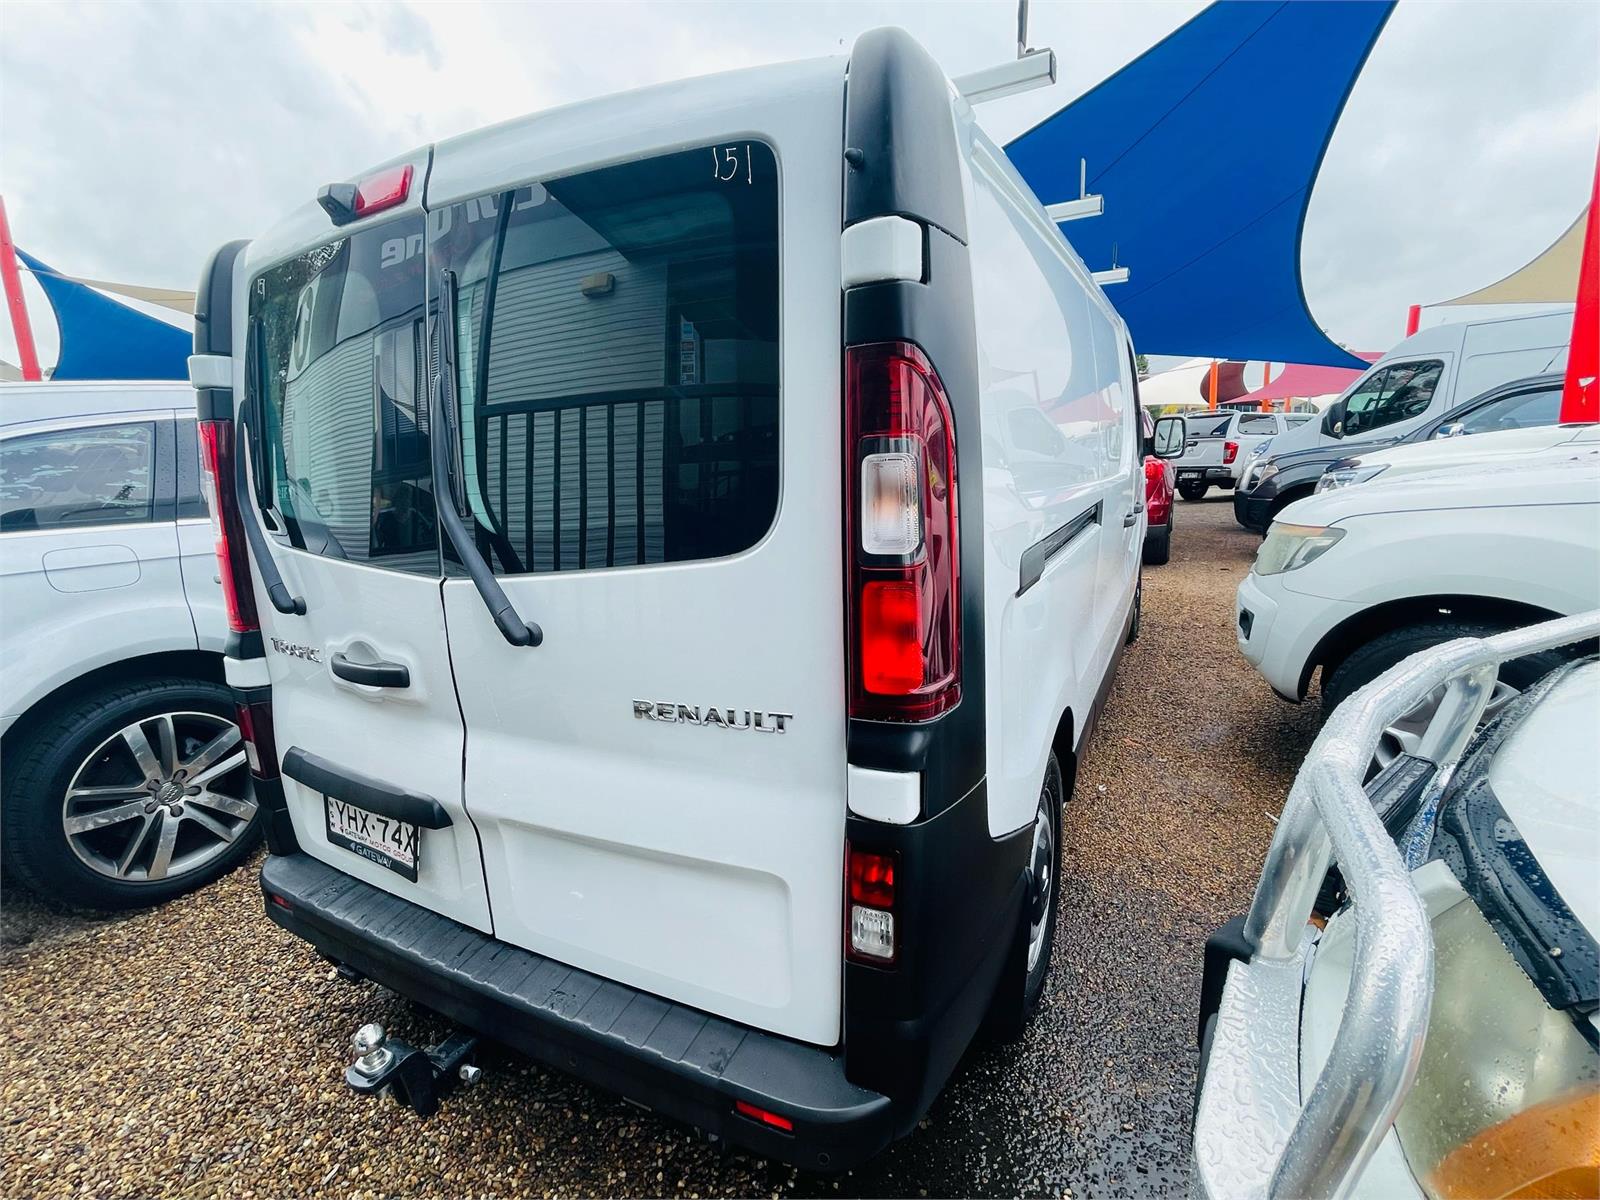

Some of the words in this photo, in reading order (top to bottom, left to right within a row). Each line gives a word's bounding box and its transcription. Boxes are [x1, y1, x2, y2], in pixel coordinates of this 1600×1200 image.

[713, 144, 752, 185] 151
[632, 698, 793, 734] RENAULT
[355, 845, 393, 868] GATEWAY
